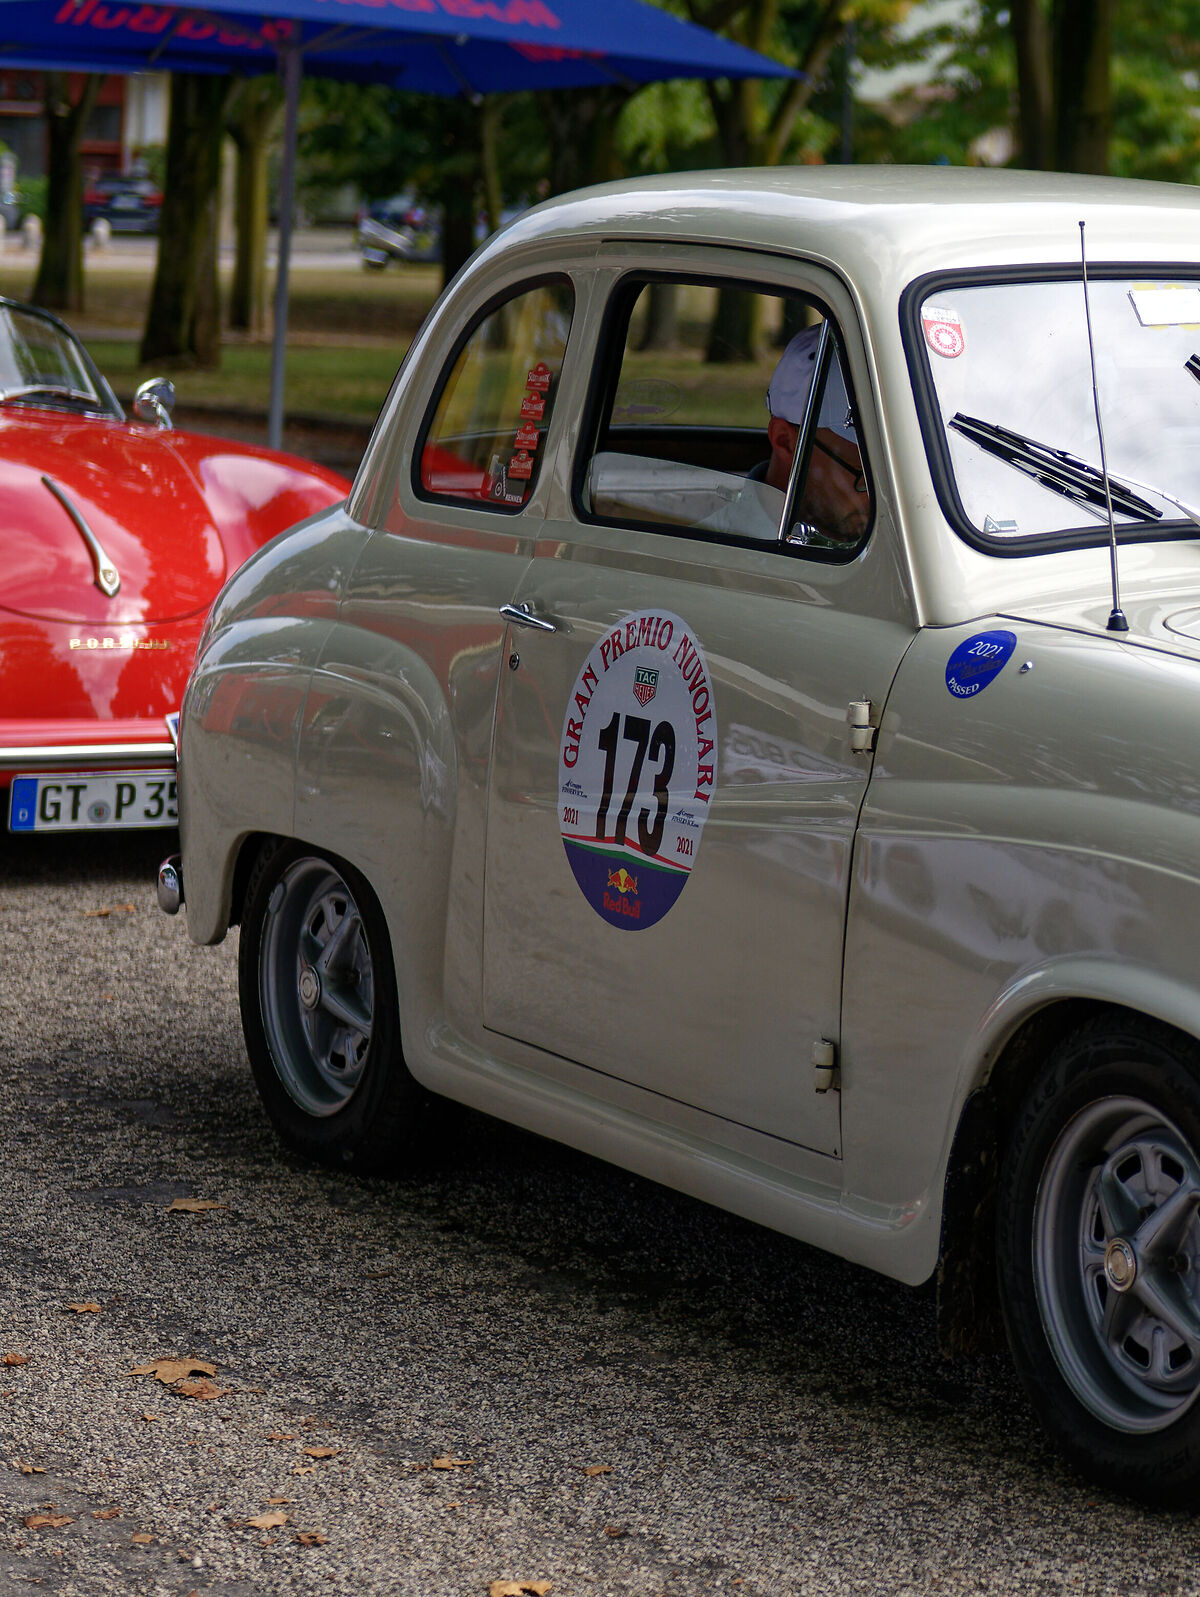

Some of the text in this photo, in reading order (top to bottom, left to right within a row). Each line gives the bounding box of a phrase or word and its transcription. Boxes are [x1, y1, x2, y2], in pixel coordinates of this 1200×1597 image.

[968, 641, 1004, 658] 2021
[638, 671, 656, 685] TAG
[948, 677, 980, 695] PASSED
[635, 683, 656, 701] HEUER
[563, 663, 599, 768] GRAN
[599, 617, 674, 672] PREMIO
[672, 632, 714, 804] NUVOLARI
[596, 711, 676, 857] 173
[39, 784, 88, 821] GT
[115, 782, 137, 820] P
[563, 806, 579, 825] 2021
[677, 836, 693, 855] 2021
[603, 892, 641, 919] Red Bull
